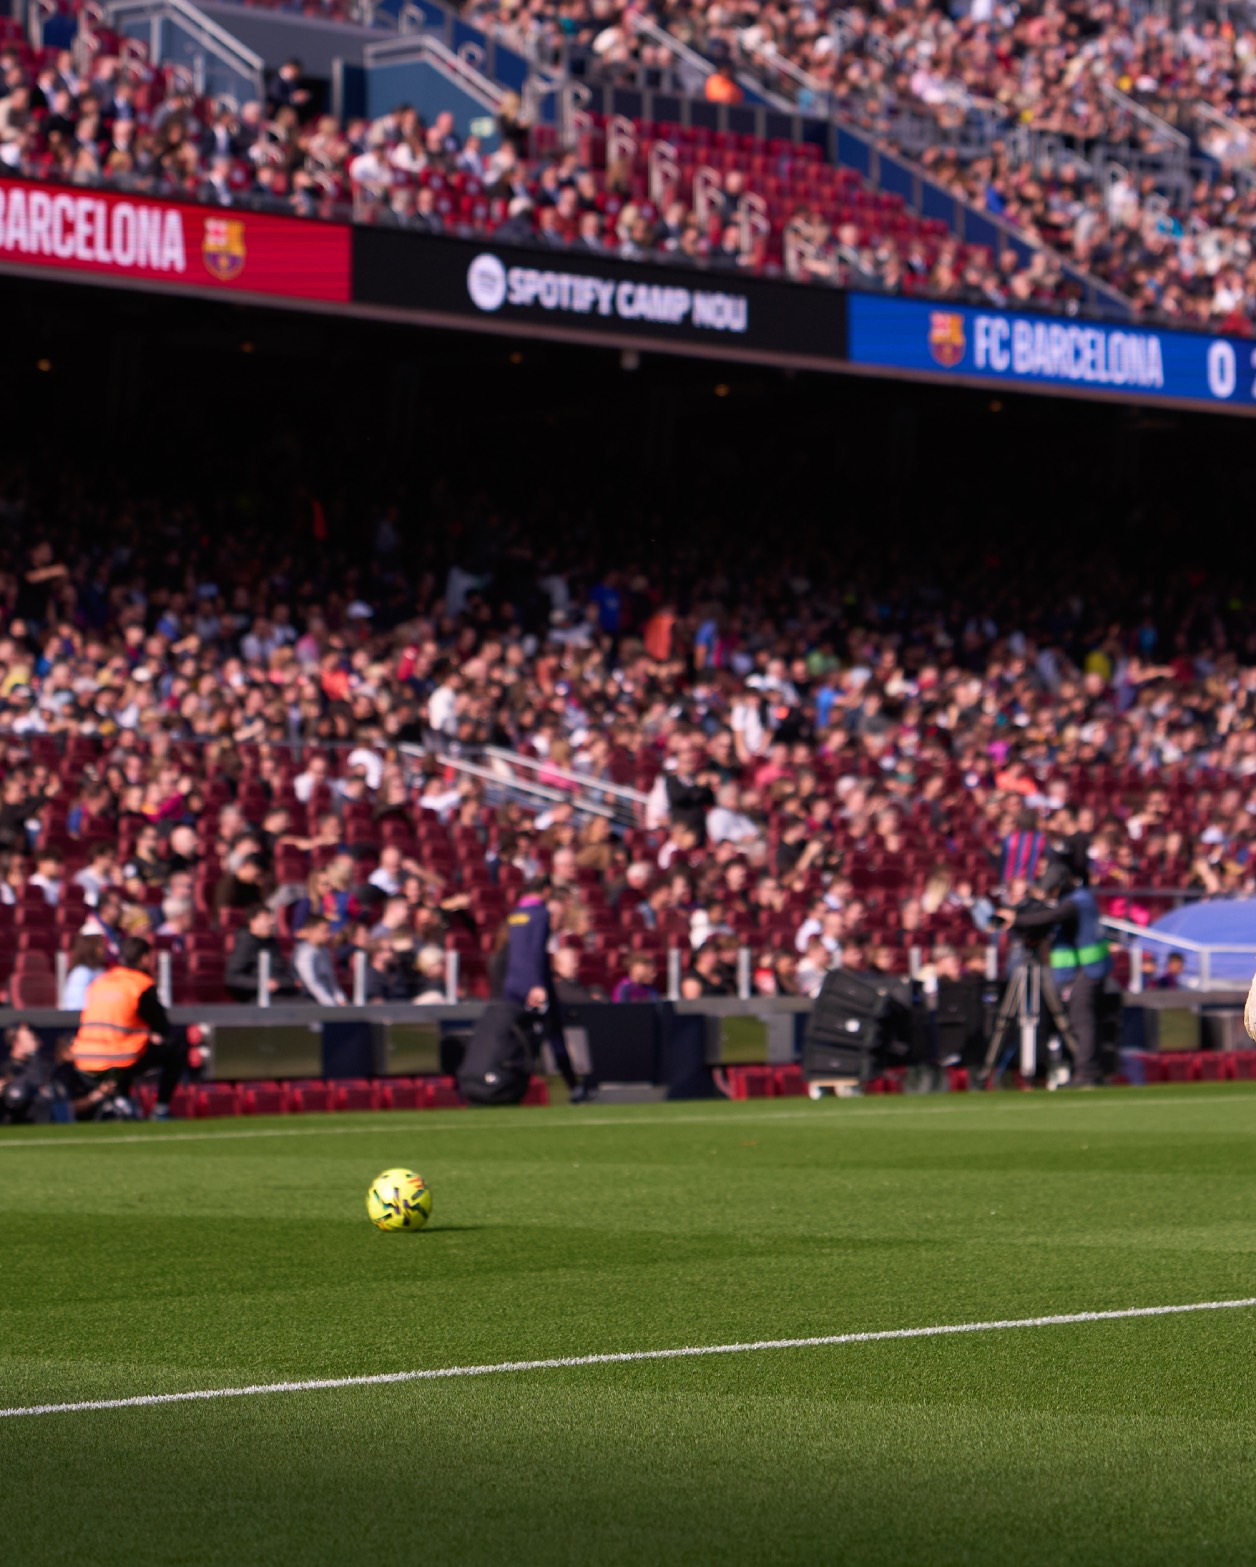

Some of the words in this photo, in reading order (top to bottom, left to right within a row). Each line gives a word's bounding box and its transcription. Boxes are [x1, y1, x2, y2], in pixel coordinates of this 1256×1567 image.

[0, 185, 187, 273] ARCELONA
[507, 265, 615, 315] SPOTIFY
[615, 280, 691, 324] CAMP
[692, 289, 748, 333] NOU
[973, 314, 1010, 372] FC
[1011, 318, 1165, 389] BARCELONA
[1207, 338, 1236, 399] 0
